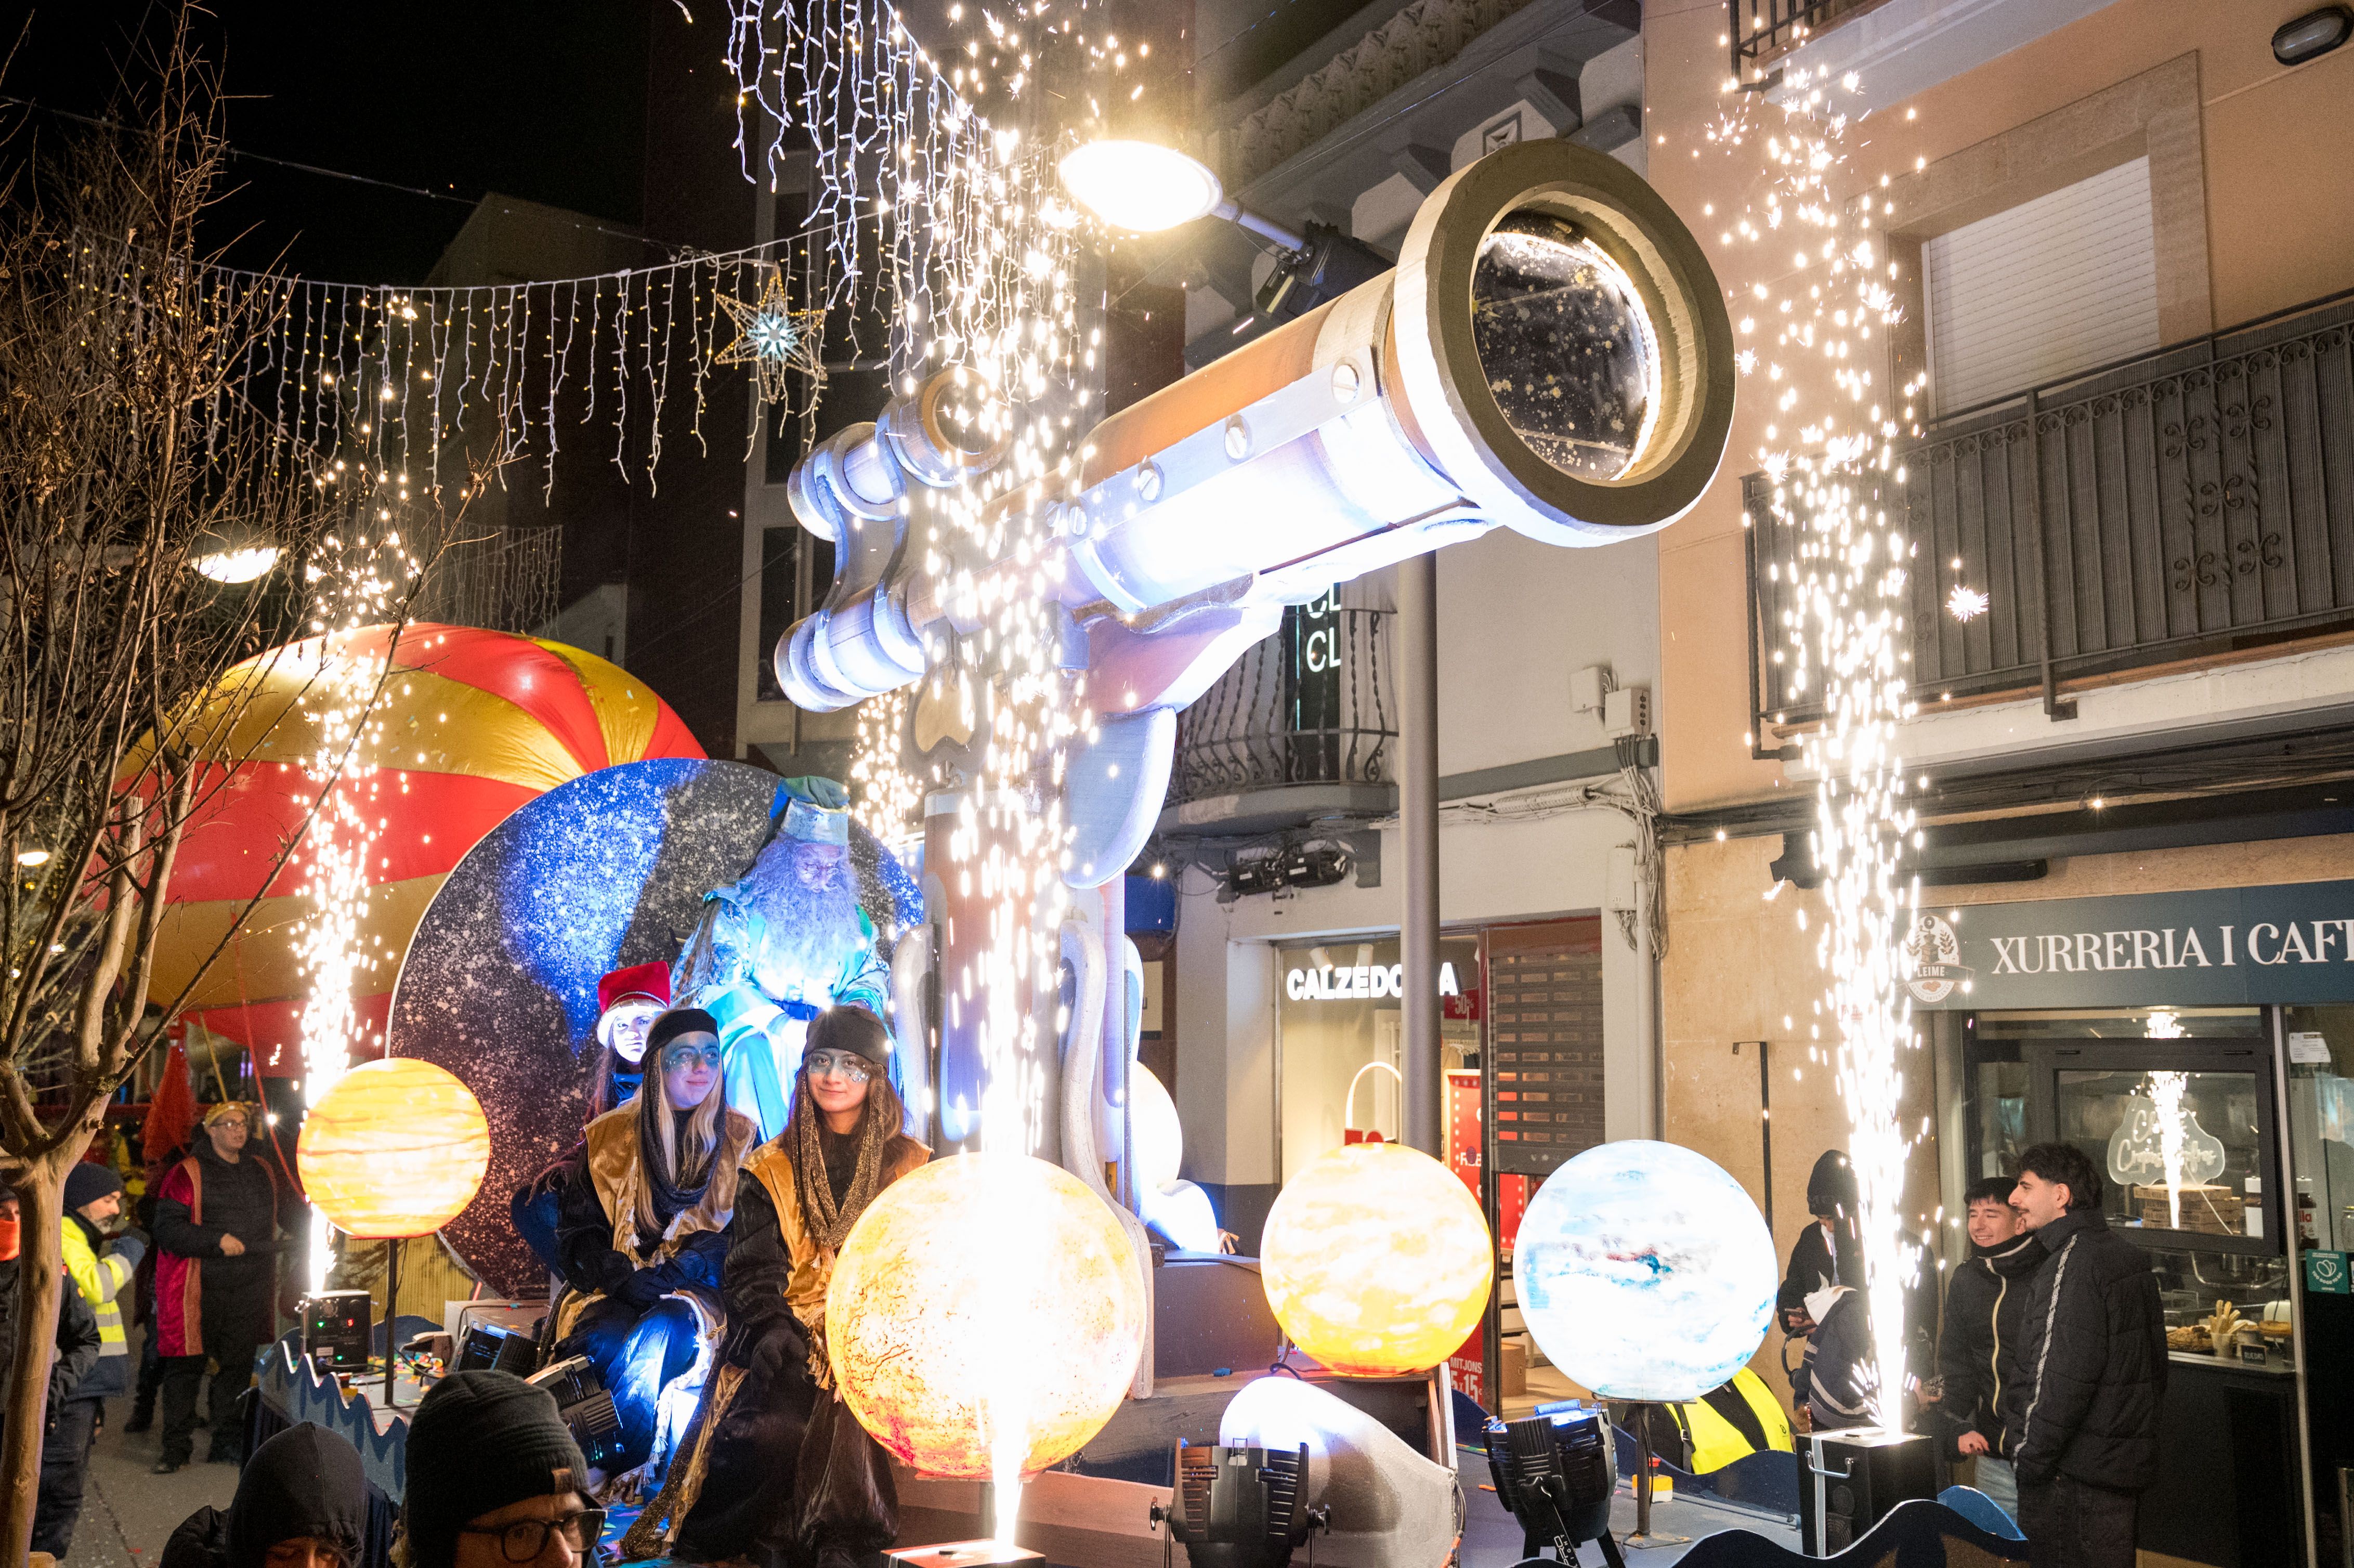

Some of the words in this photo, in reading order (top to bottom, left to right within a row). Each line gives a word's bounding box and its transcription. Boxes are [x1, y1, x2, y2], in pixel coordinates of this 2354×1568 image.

[1306, 627, 1341, 672] CL
[1990, 926, 2213, 974] XURRERIA
[2219, 925, 2237, 966] I
[1287, 962, 1459, 1001] CALZEDOA
[1917, 965, 1945, 977] LEIME
[1450, 1356, 1483, 1374] MITJONS
